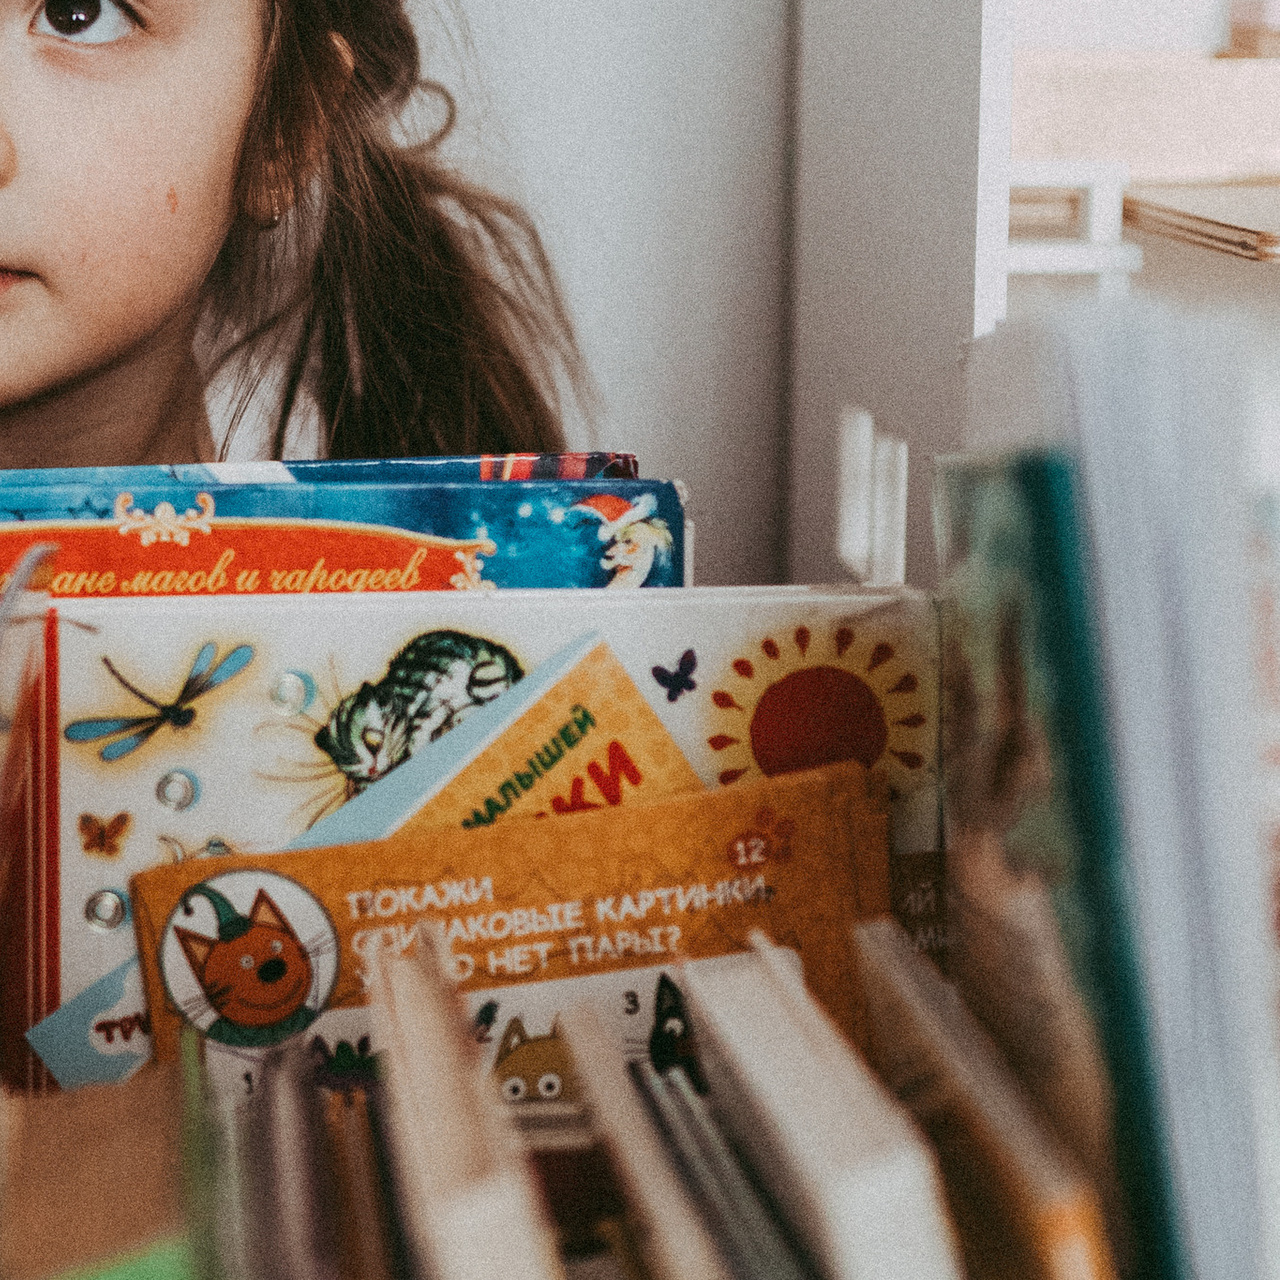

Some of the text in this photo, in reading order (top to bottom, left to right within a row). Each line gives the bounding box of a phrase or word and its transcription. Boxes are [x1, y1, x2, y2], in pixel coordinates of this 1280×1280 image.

[122, 548, 235, 594] магов
[236, 568, 262, 593] и
[270, 547, 428, 594] чародеев
[735, 837, 766, 867] 12
[346, 876, 495, 920] ПОКАЖИ
[487, 941, 554, 976] НЕТ
[569, 924, 682, 965] ПАРЫ?
[622, 989, 641, 1017] 3
